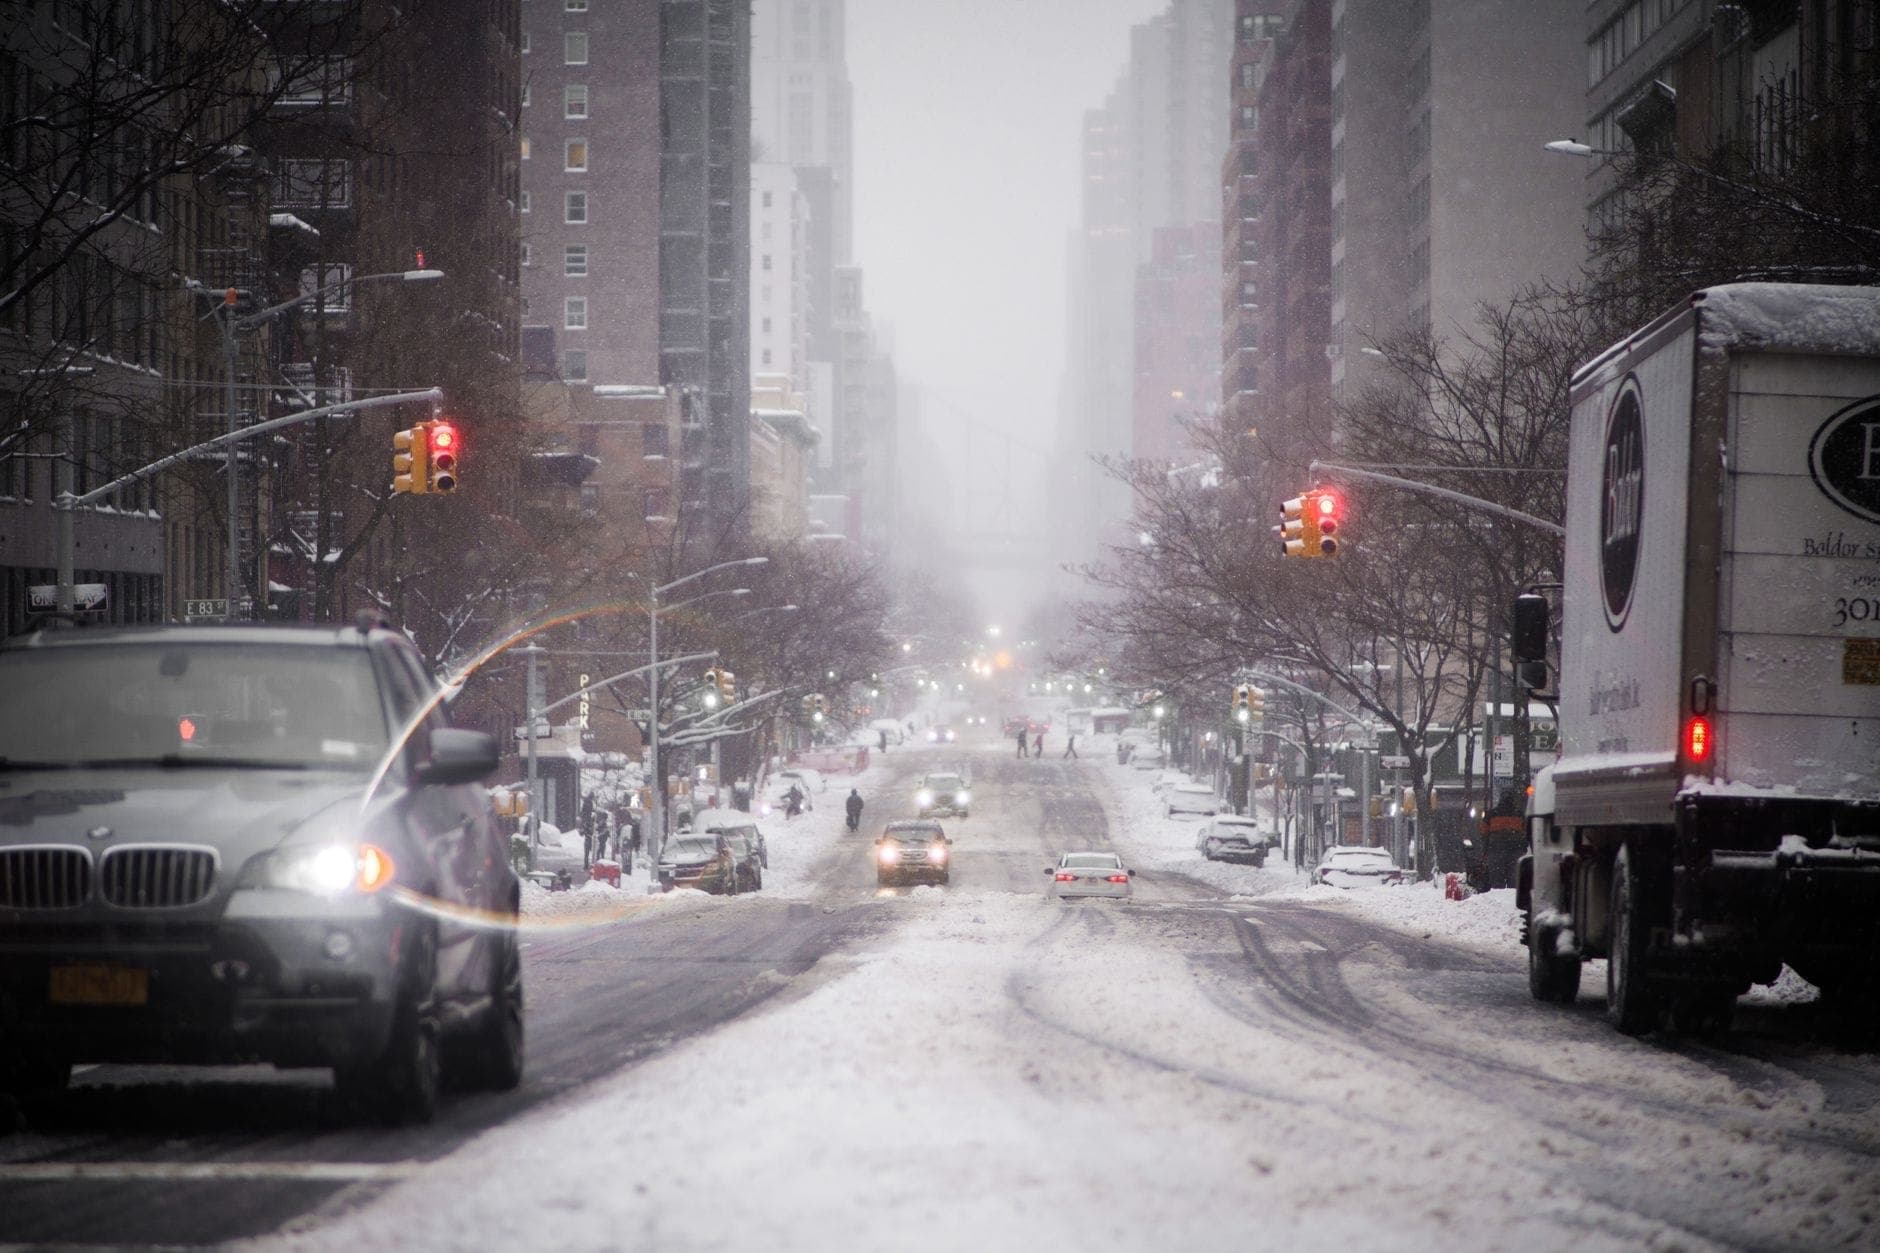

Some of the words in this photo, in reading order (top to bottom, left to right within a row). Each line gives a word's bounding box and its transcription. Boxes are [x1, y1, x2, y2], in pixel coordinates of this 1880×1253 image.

[187, 602, 194, 615] E
[199, 601, 213, 615] 83
[580, 674, 590, 729] PARK
